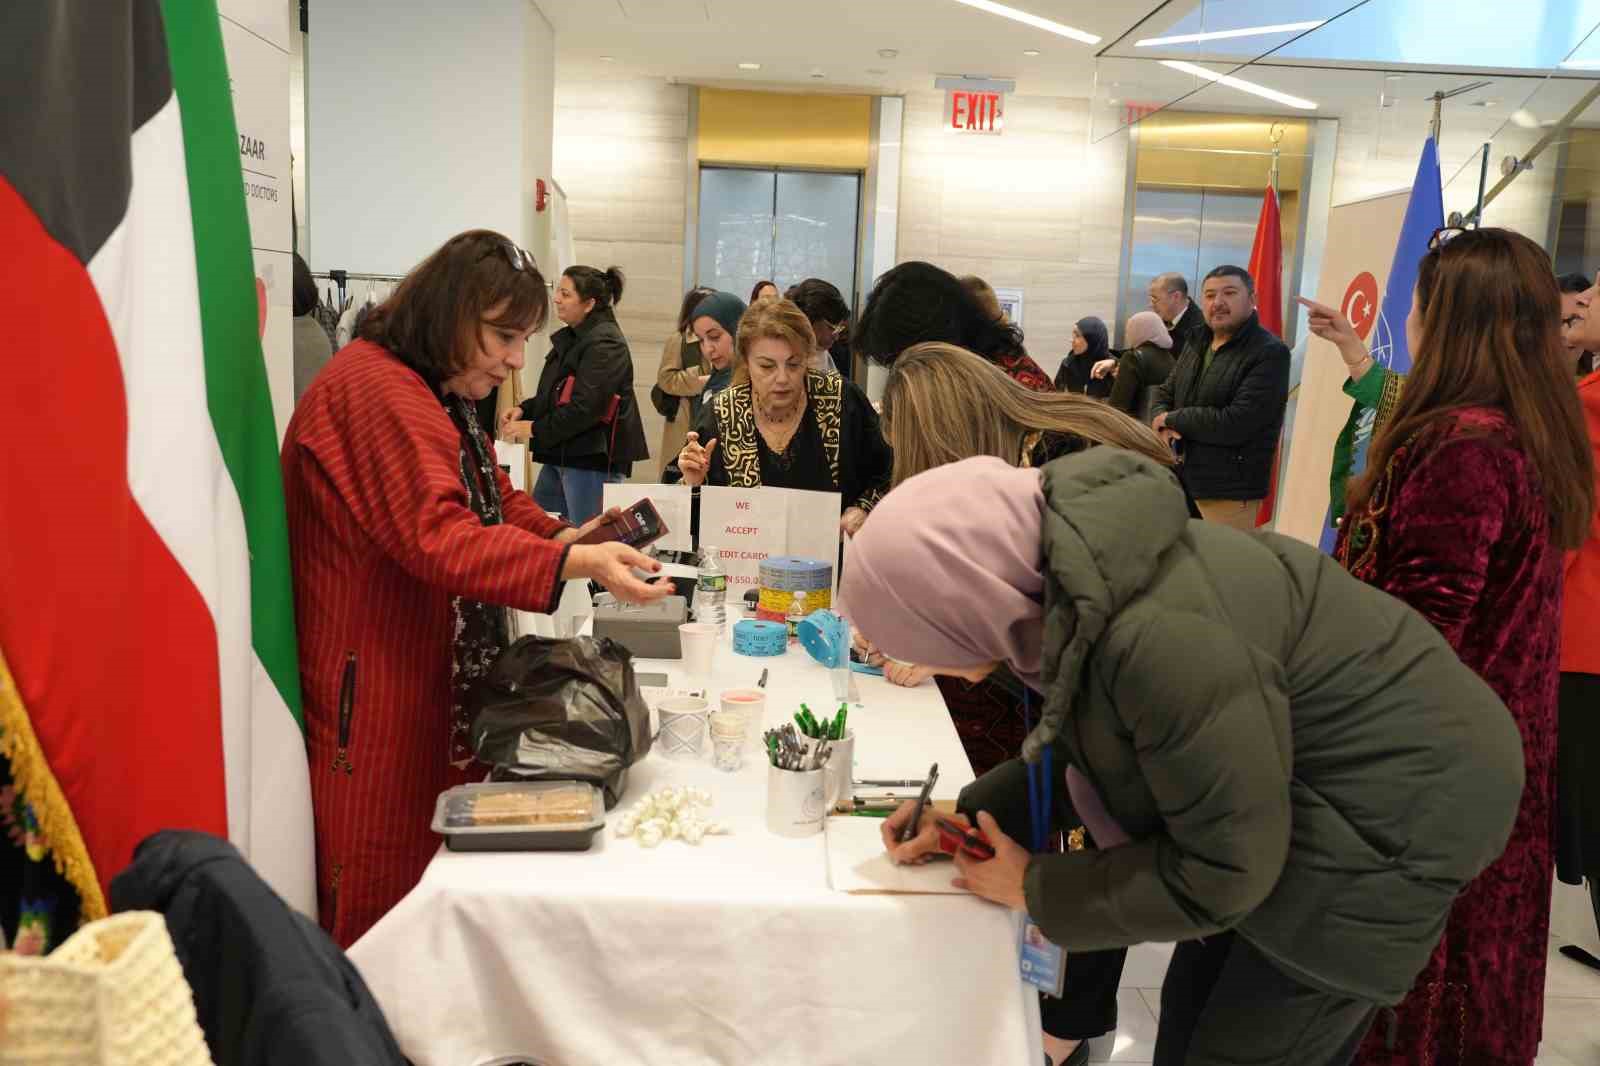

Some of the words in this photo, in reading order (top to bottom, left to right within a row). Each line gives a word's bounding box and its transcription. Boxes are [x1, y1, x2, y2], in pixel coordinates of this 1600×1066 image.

[952, 93, 999, 131] EXIT
[240, 134, 265, 161] ZAAR
[735, 501, 751, 511] WE
[725, 525, 759, 536] ACCEPT
[720, 550, 739, 560] EDIT
